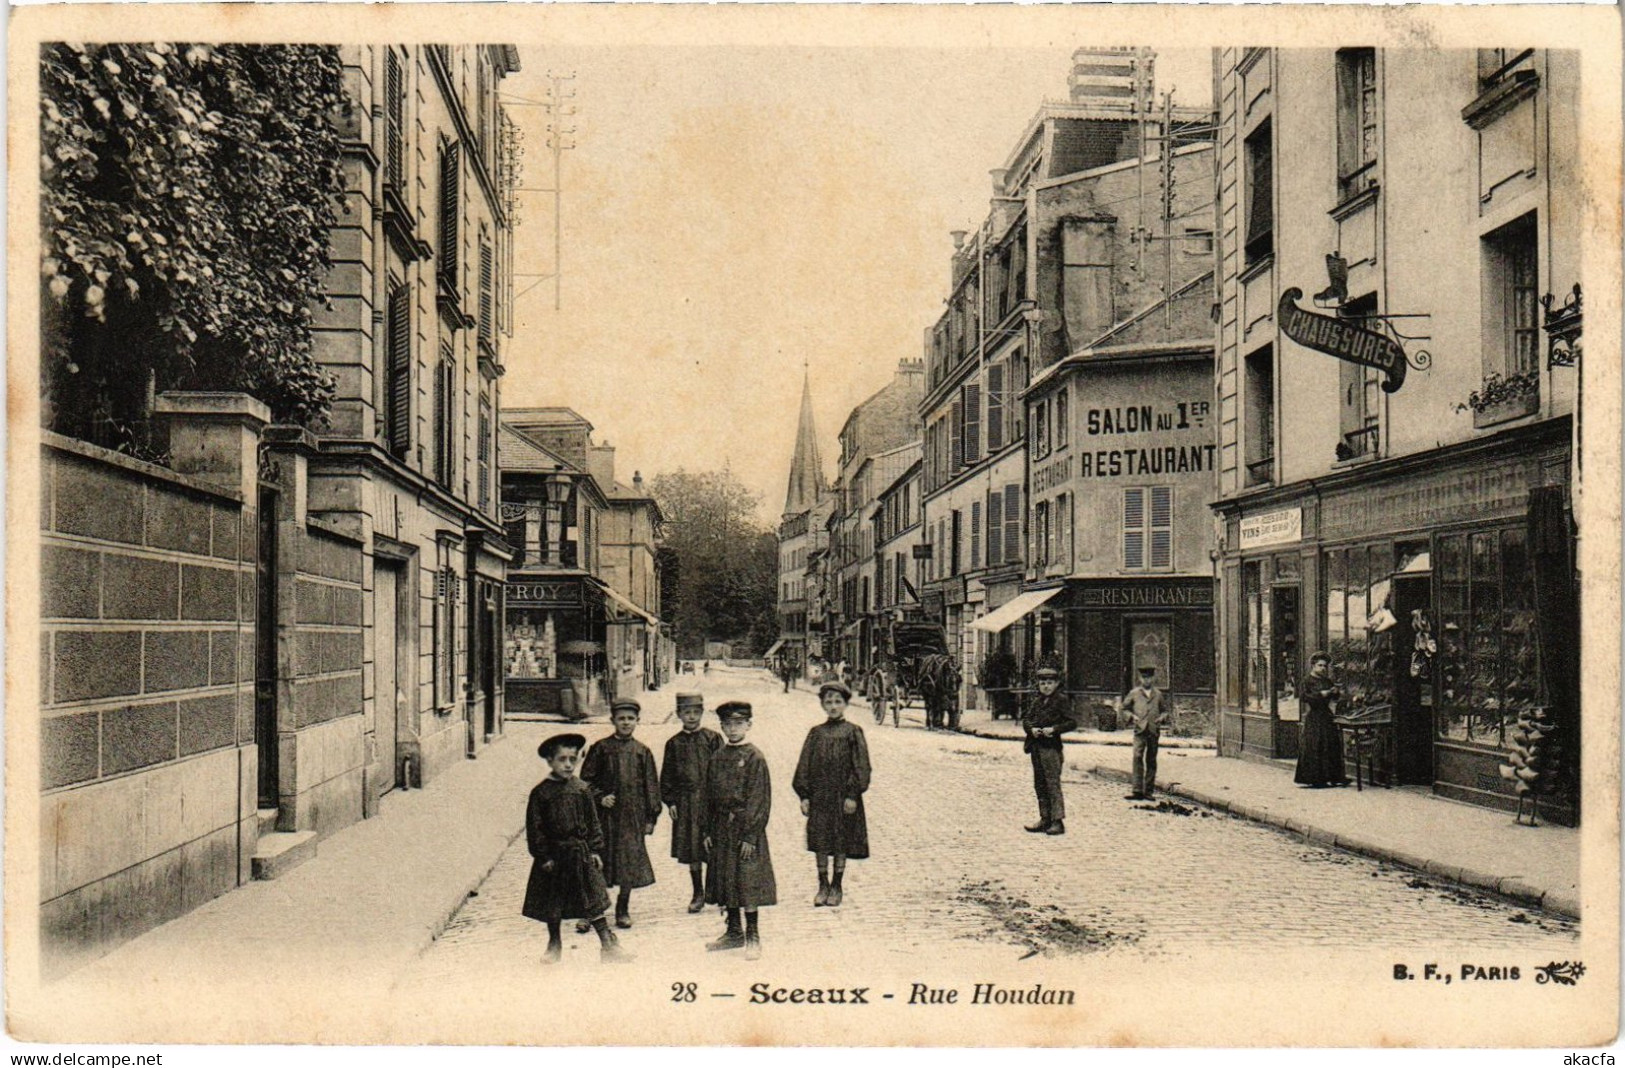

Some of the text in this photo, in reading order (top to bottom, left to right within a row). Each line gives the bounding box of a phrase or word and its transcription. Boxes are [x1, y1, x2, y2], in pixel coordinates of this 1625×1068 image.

[1287, 310, 1397, 368] CHAUSSURES
[1088, 406, 1152, 435] SALON
[1157, 413, 1172, 431] AU
[1032, 454, 1074, 495] RESTAURANT
[1082, 444, 1216, 478] RESTAURANT
[1242, 527, 1260, 539] VINS
[1101, 587, 1194, 605] RESTAURANT
